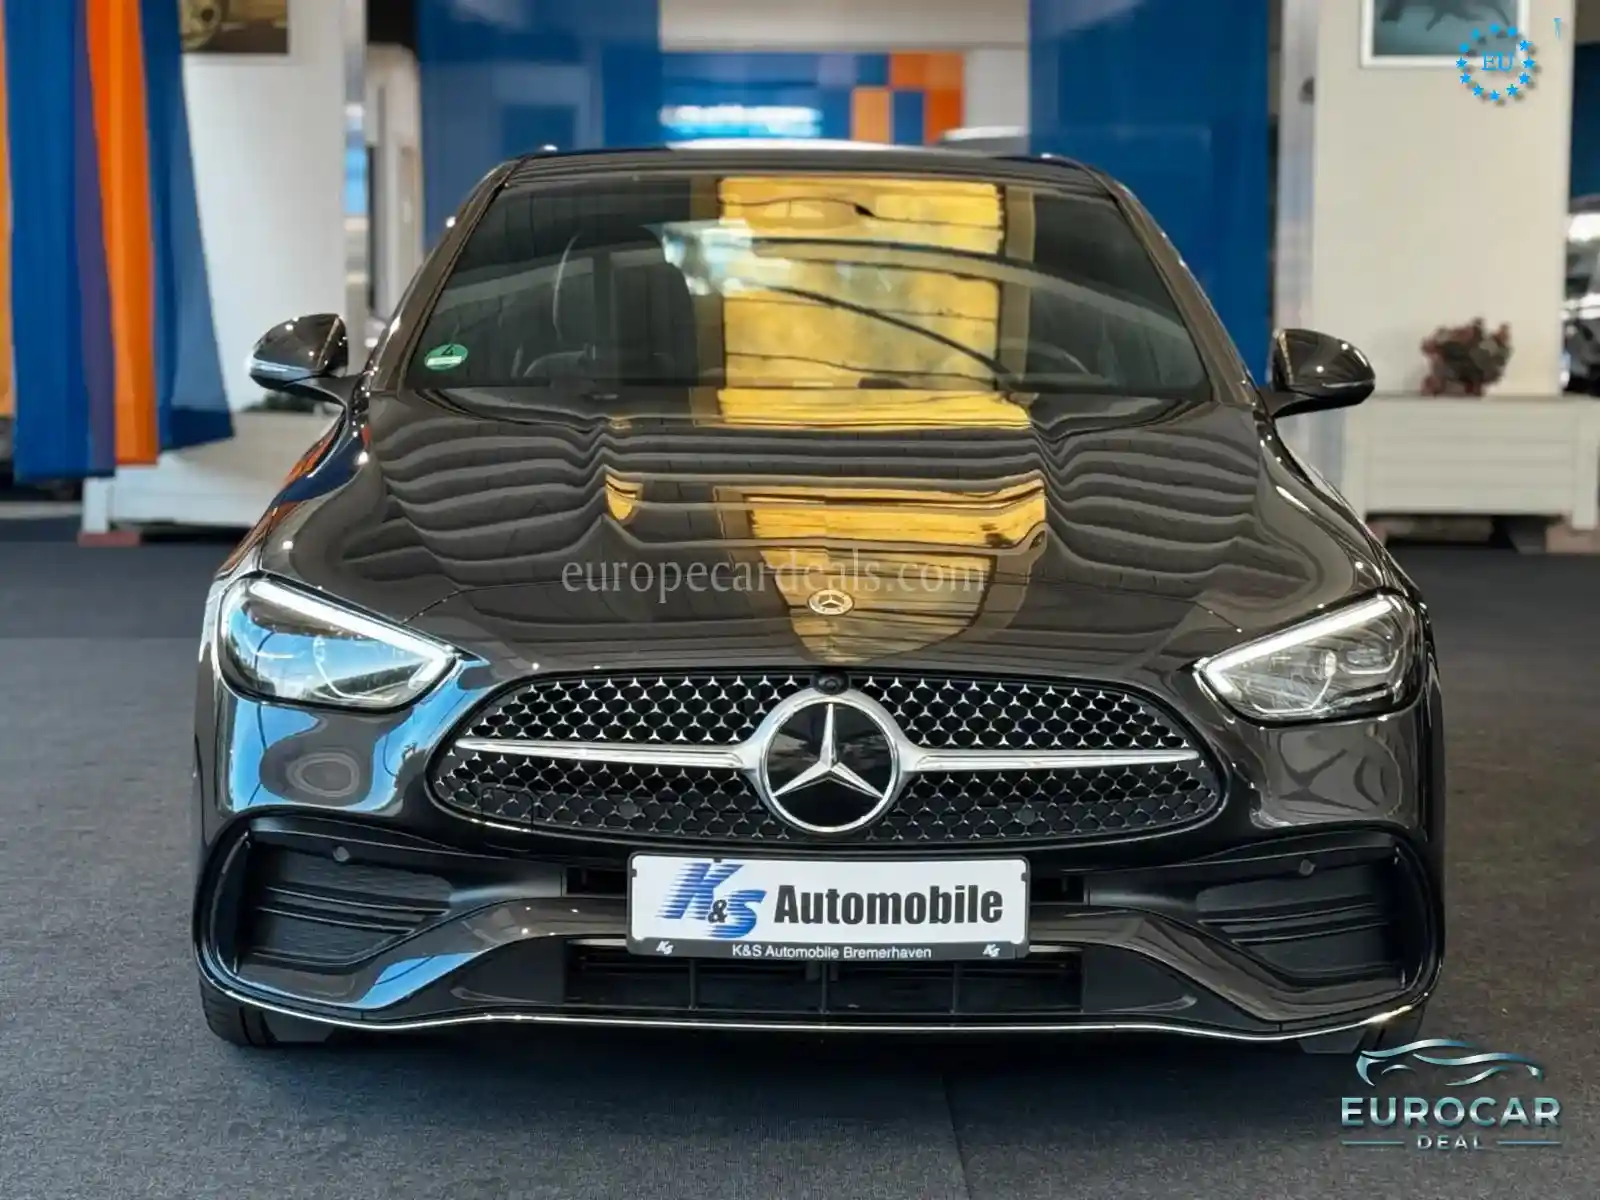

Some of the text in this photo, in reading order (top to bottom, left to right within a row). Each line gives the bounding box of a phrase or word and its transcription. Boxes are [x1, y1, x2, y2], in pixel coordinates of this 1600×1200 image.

[773, 884, 1004, 926] Automobile
[732, 943, 932, 960] K&S Automobile Bremerhaven
